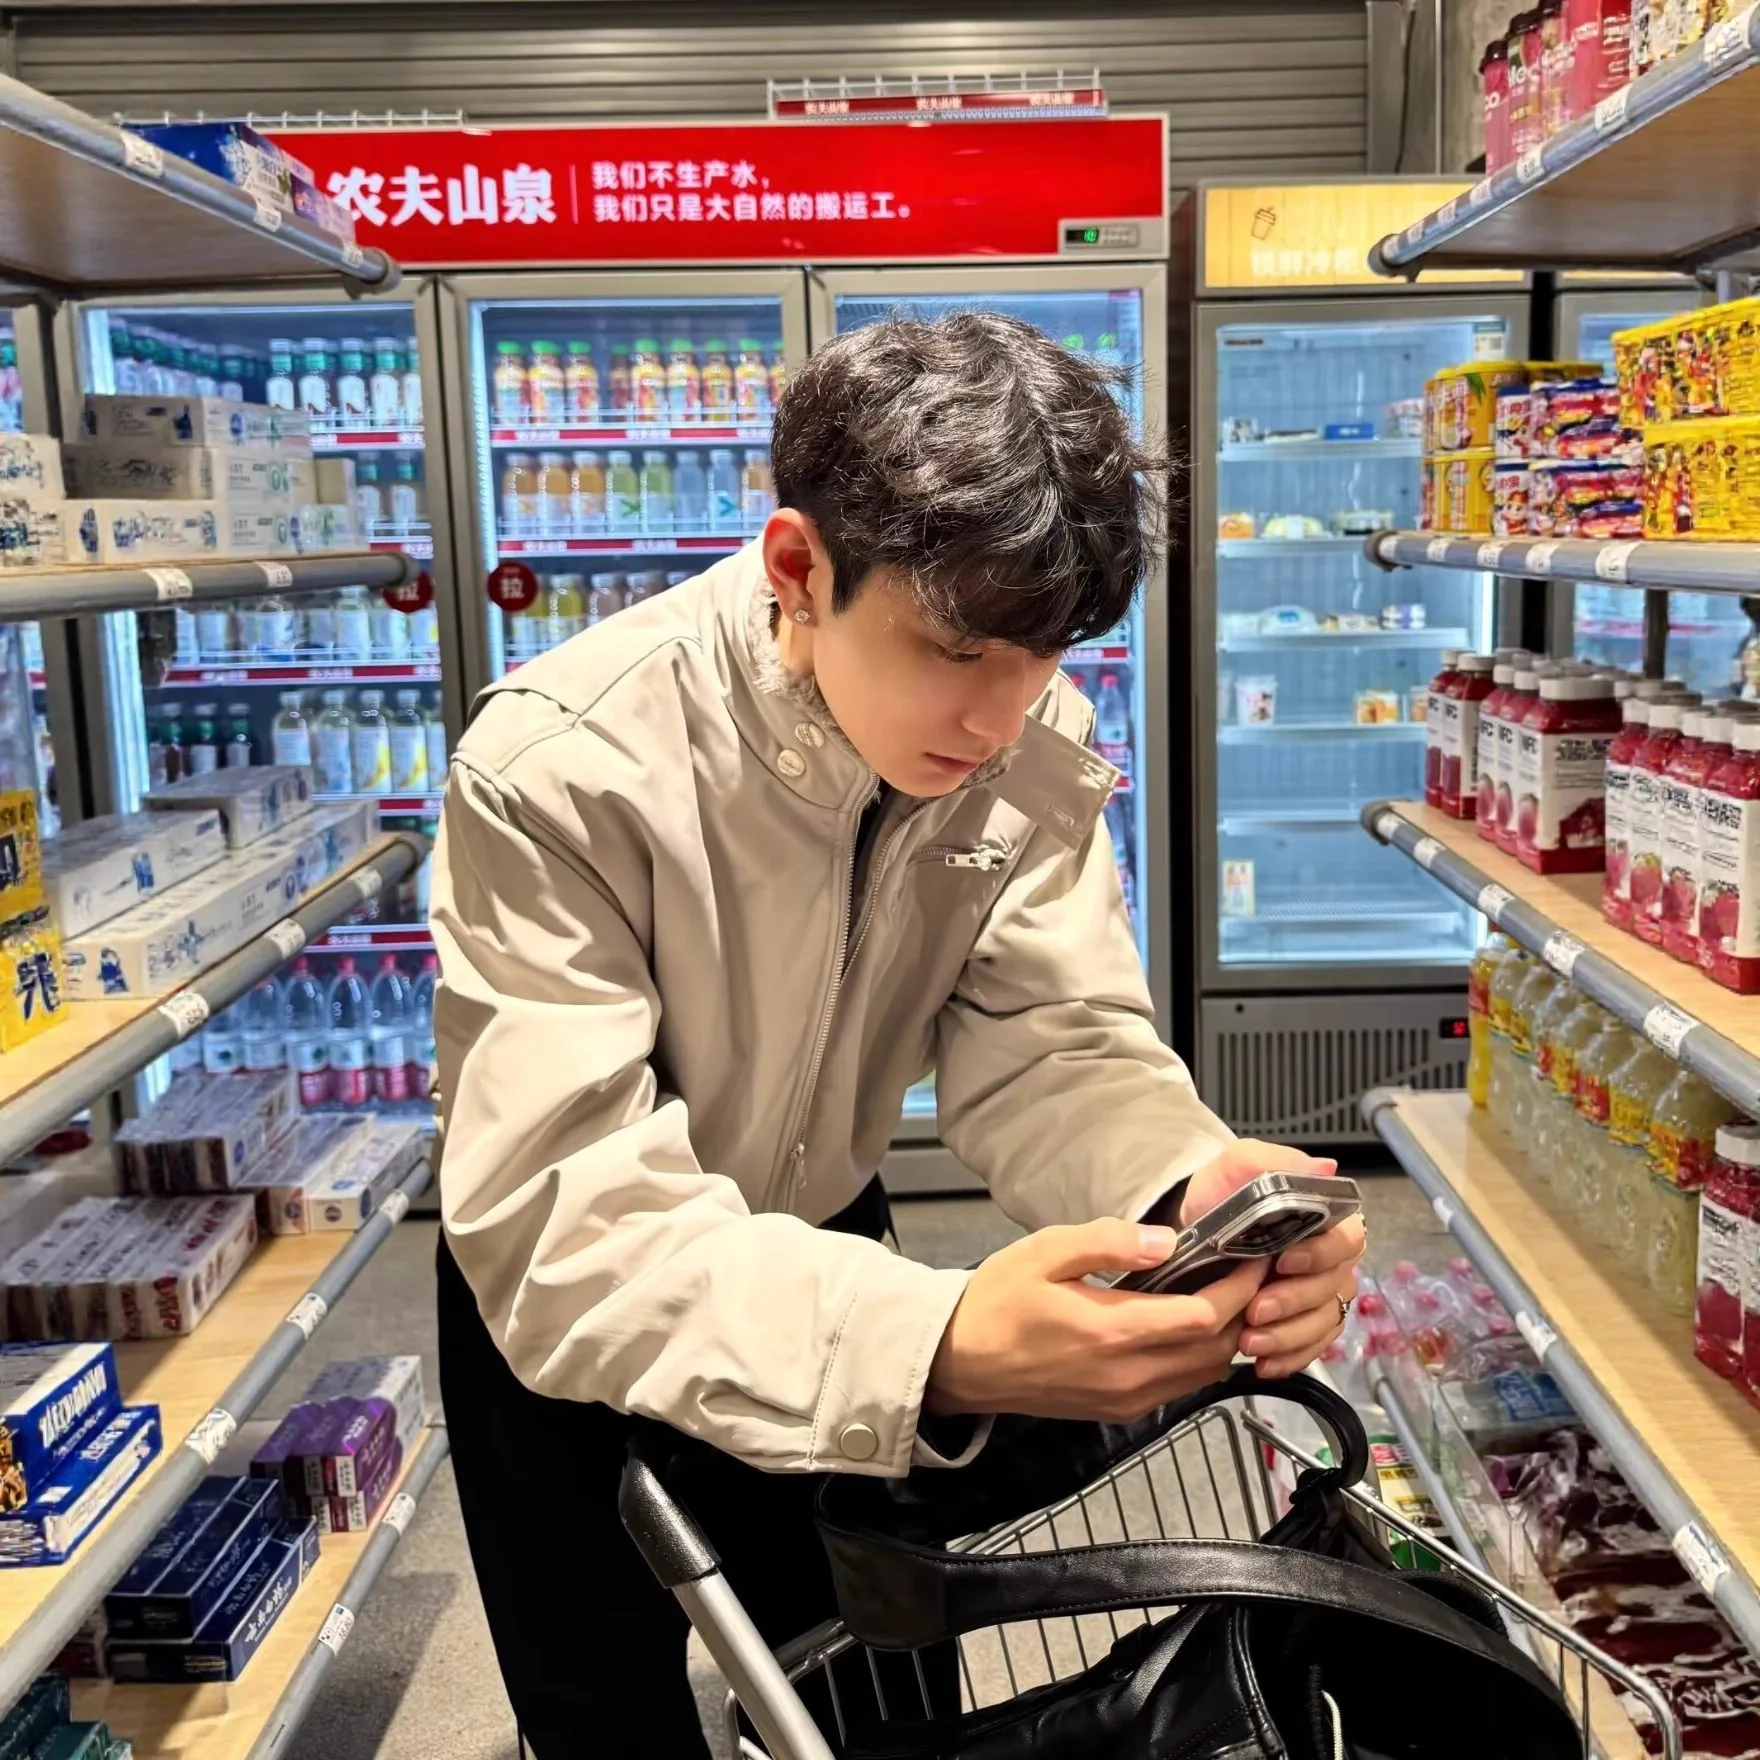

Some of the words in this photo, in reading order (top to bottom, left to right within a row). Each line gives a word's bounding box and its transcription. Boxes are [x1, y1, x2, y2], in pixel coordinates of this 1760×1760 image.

[591, 160, 769, 189] 我们不生产水，
[327, 163, 556, 227] 农夫山泉
[594, 191, 910, 223] 我们只是大自然的搬运工。
